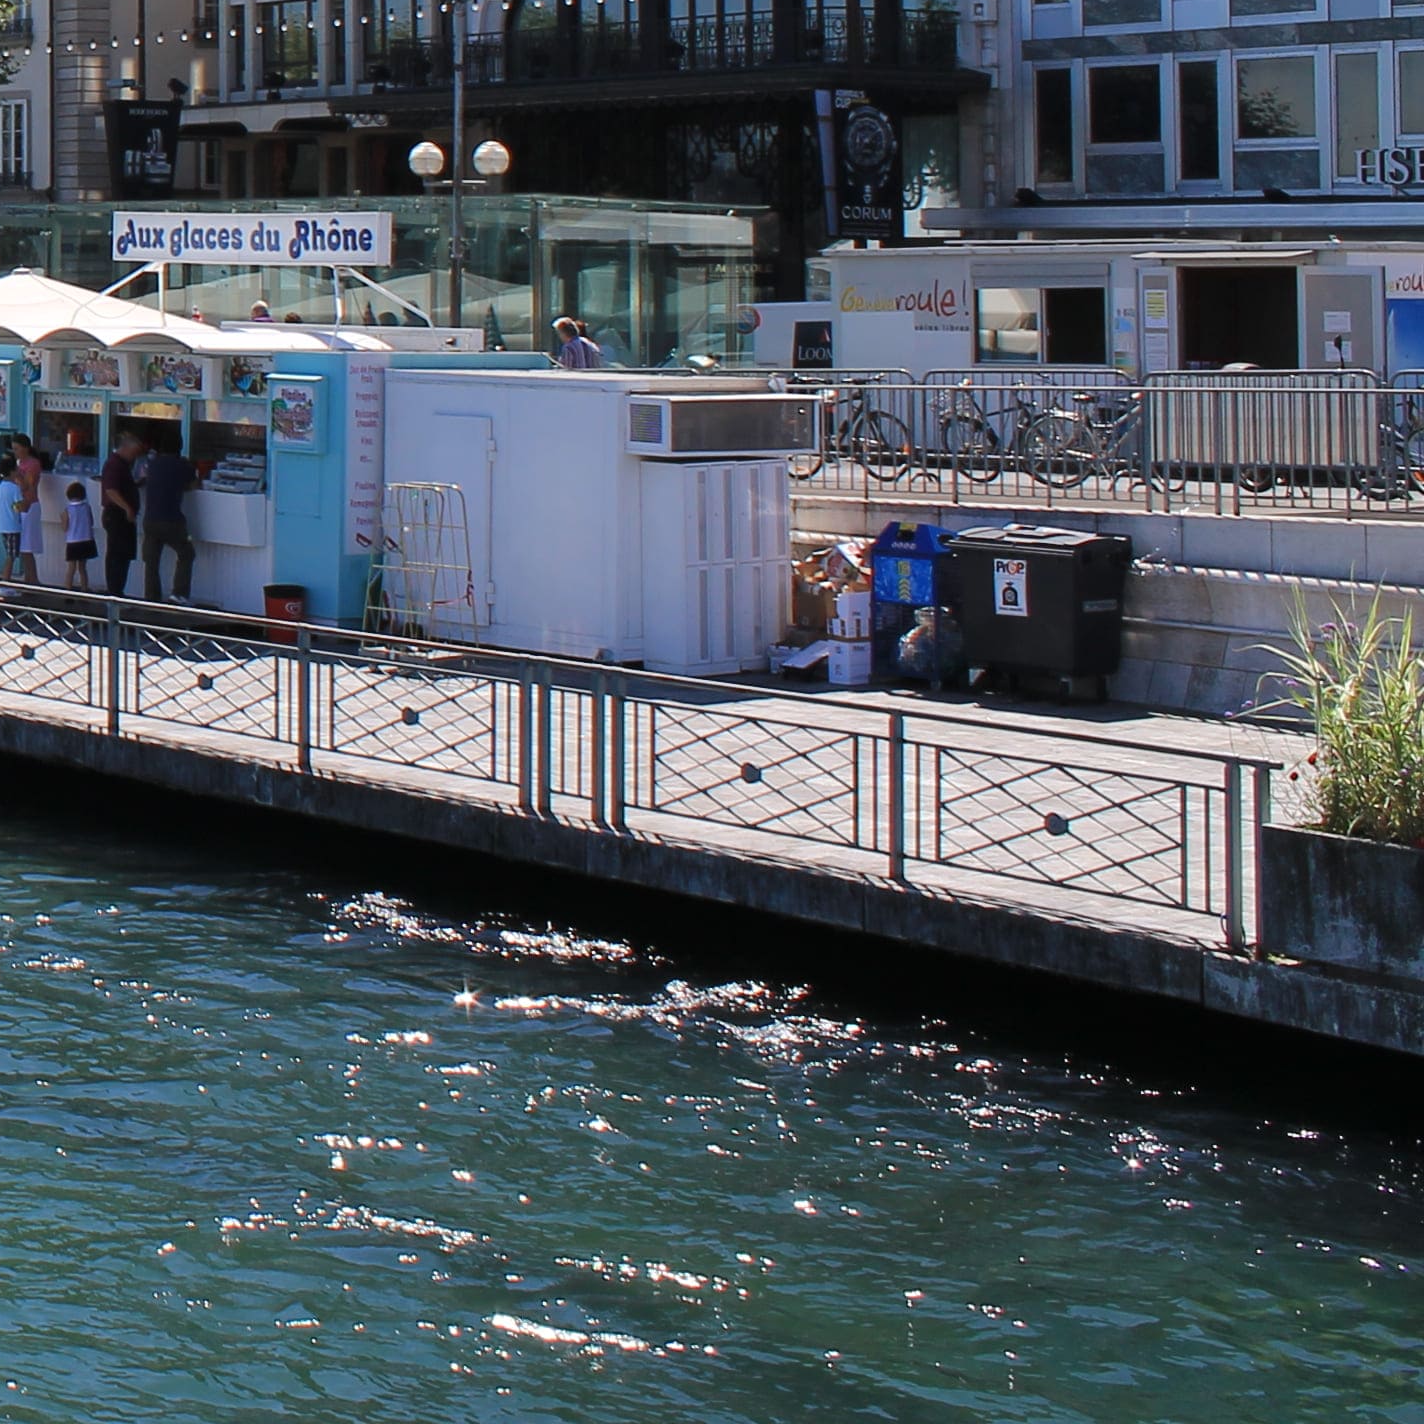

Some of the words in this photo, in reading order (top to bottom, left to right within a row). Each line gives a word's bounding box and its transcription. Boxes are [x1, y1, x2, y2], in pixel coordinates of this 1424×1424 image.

[841, 205, 892, 221] CORUM
[117, 219, 165, 256] Aux
[170, 220, 243, 257] glaces
[251, 221, 281, 252] du
[289, 218, 373, 258] Rhône
